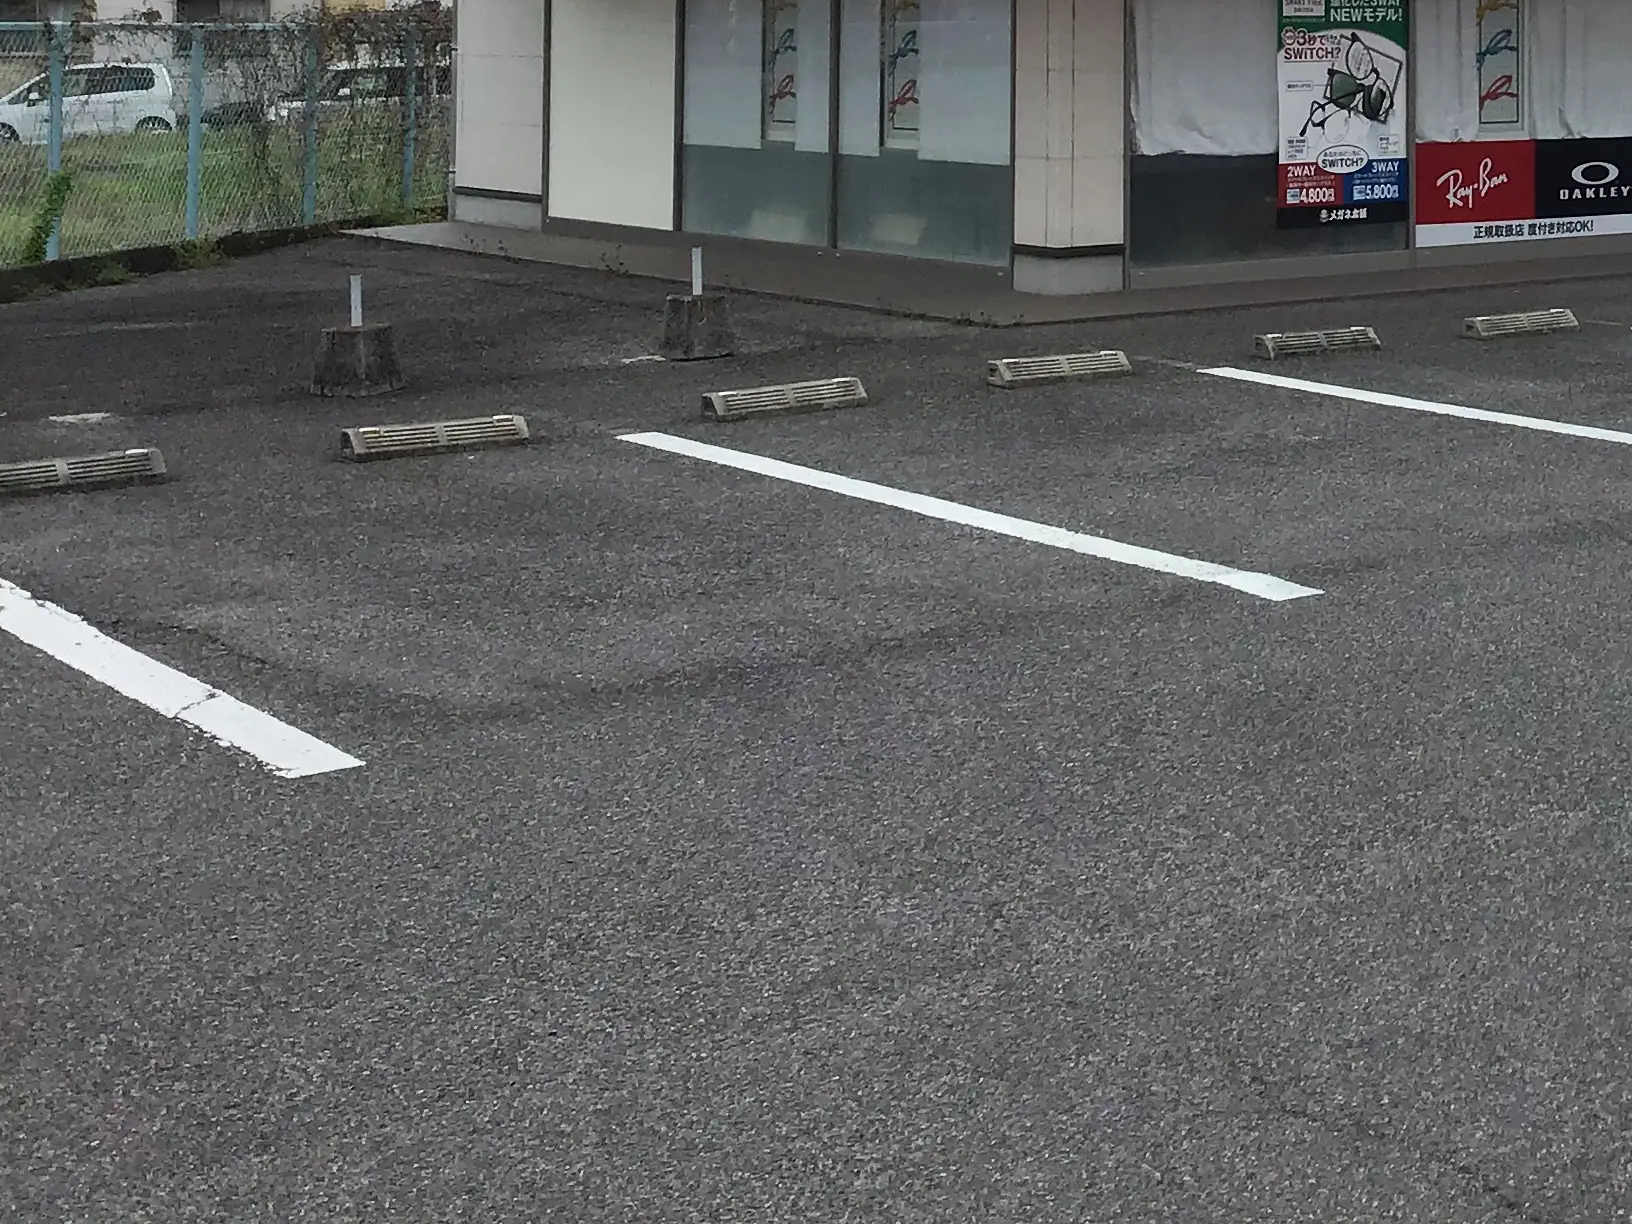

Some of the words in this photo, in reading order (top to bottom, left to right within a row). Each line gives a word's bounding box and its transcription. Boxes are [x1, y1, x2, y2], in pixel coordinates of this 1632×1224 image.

[1284, 47, 1342, 60] SWITCH?
[1321, 157, 1364, 169] SWITCH?
[1371, 161, 1400, 173] 3WAY
[1287, 165, 1316, 177] 2WAY
[1436, 157, 1508, 208] Ray-Ban
[1559, 186, 1630, 200] OAKLEY
